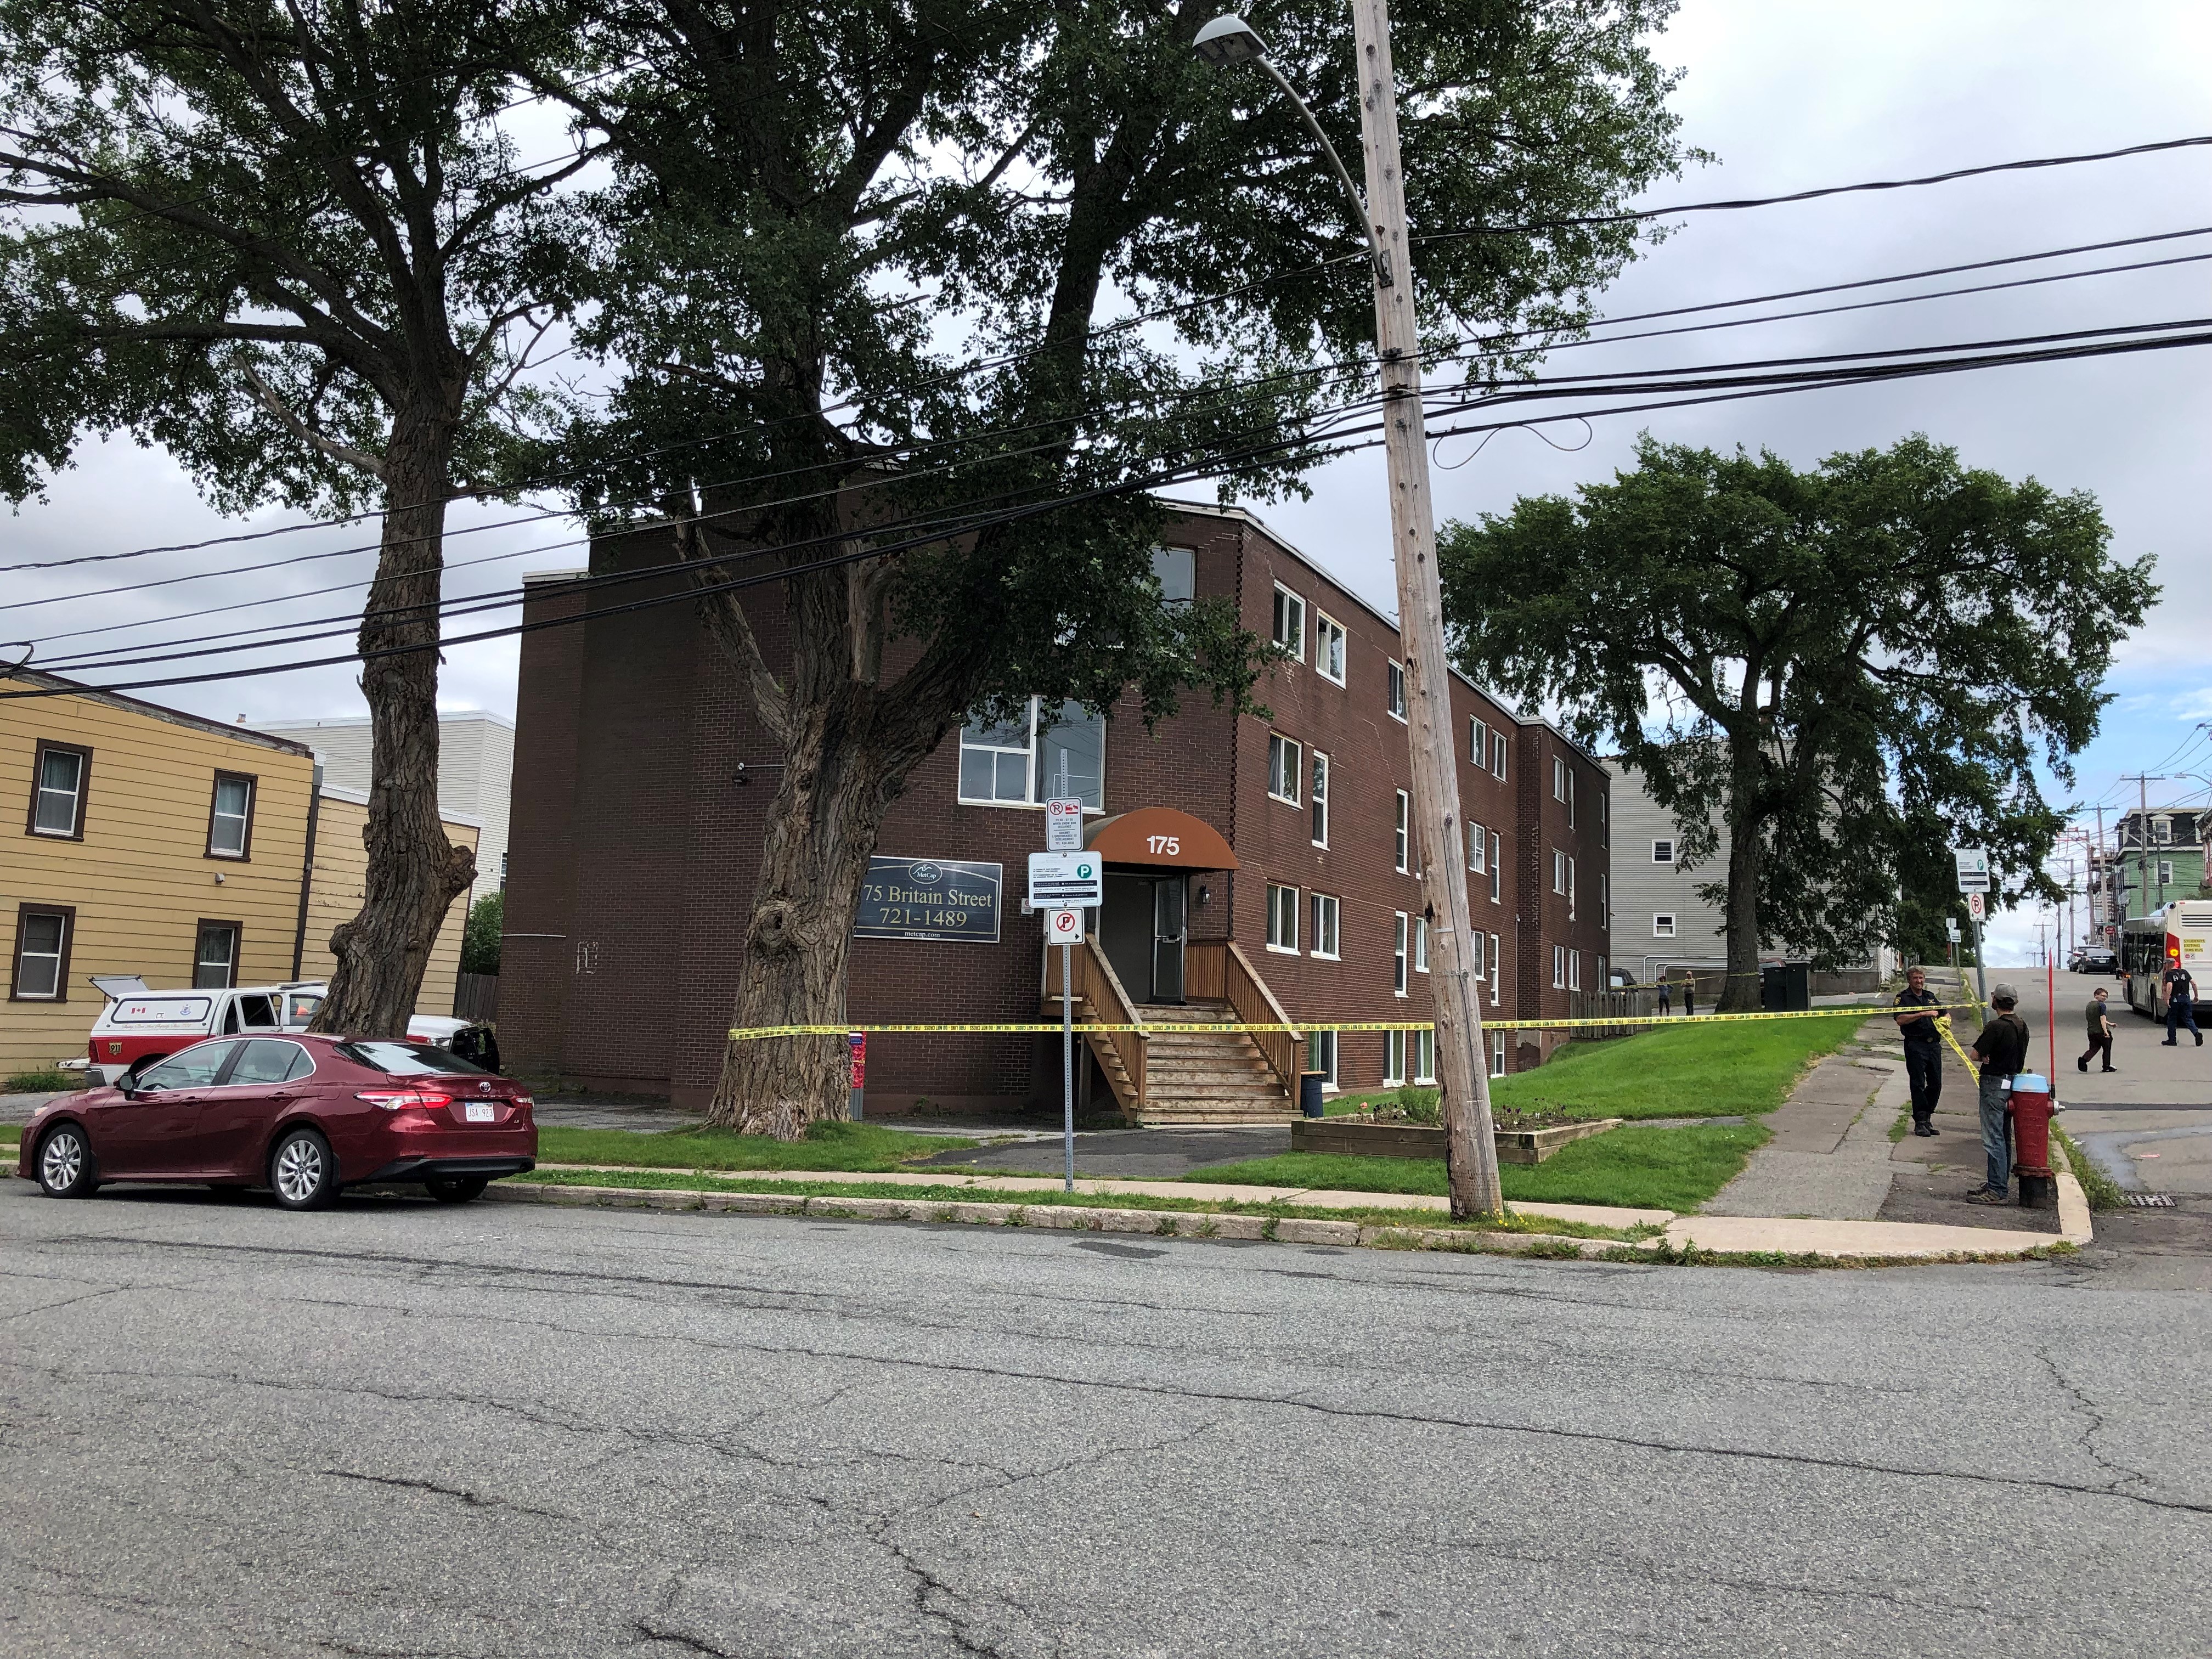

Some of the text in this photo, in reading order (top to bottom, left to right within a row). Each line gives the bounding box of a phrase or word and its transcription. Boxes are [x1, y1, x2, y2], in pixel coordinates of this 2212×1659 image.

[1147, 836, 1180, 856] 175
[864, 884, 992, 907] 75 Britain Street
[879, 908, 967, 927] 721-1489
[469, 1108, 493, 1117] JSA 923
